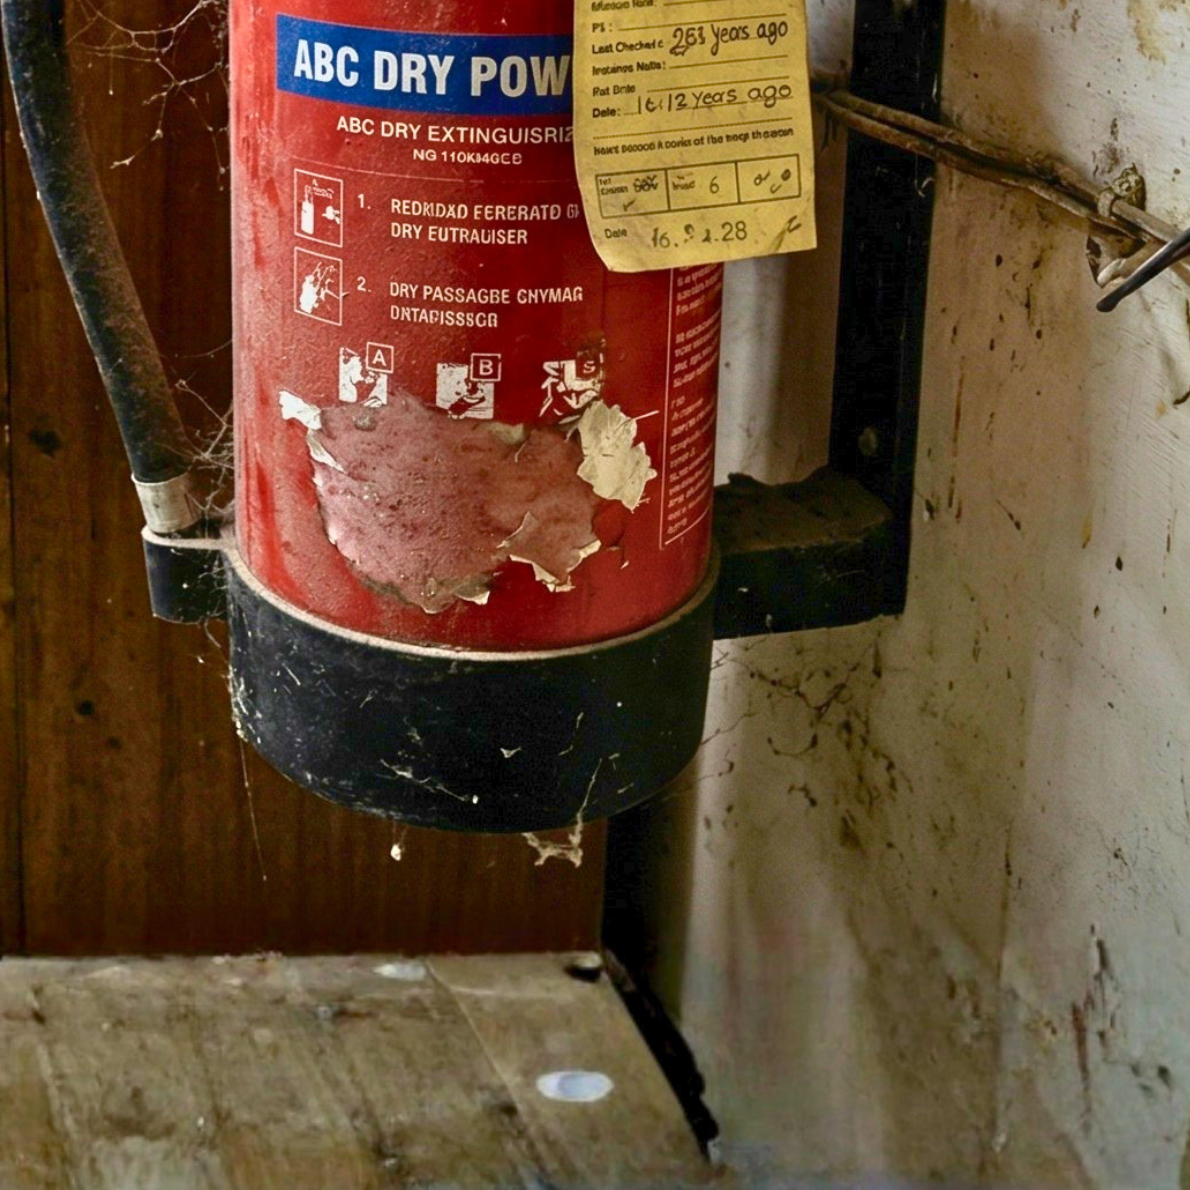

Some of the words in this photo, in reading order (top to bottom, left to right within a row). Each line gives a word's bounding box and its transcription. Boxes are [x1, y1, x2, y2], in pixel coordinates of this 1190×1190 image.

[756, 21, 789, 46] ago
[294, 39, 360, 88] ABC
[373, 50, 455, 96] DRY
[470, 55, 572, 98] POW
[747, 84, 792, 109] ago
[336, 116, 375, 136] ABC
[380, 121, 422, 140] DRY
[413, 148, 437, 161] NG
[709, 175, 720, 195] 6
[357, 193, 372, 210] 1.
[390, 222, 423, 240] DRY
[357, 276, 372, 293] 2.
[390, 281, 419, 299] DRY
[373, 350, 388, 367] A
[479, 359, 493, 376] B
